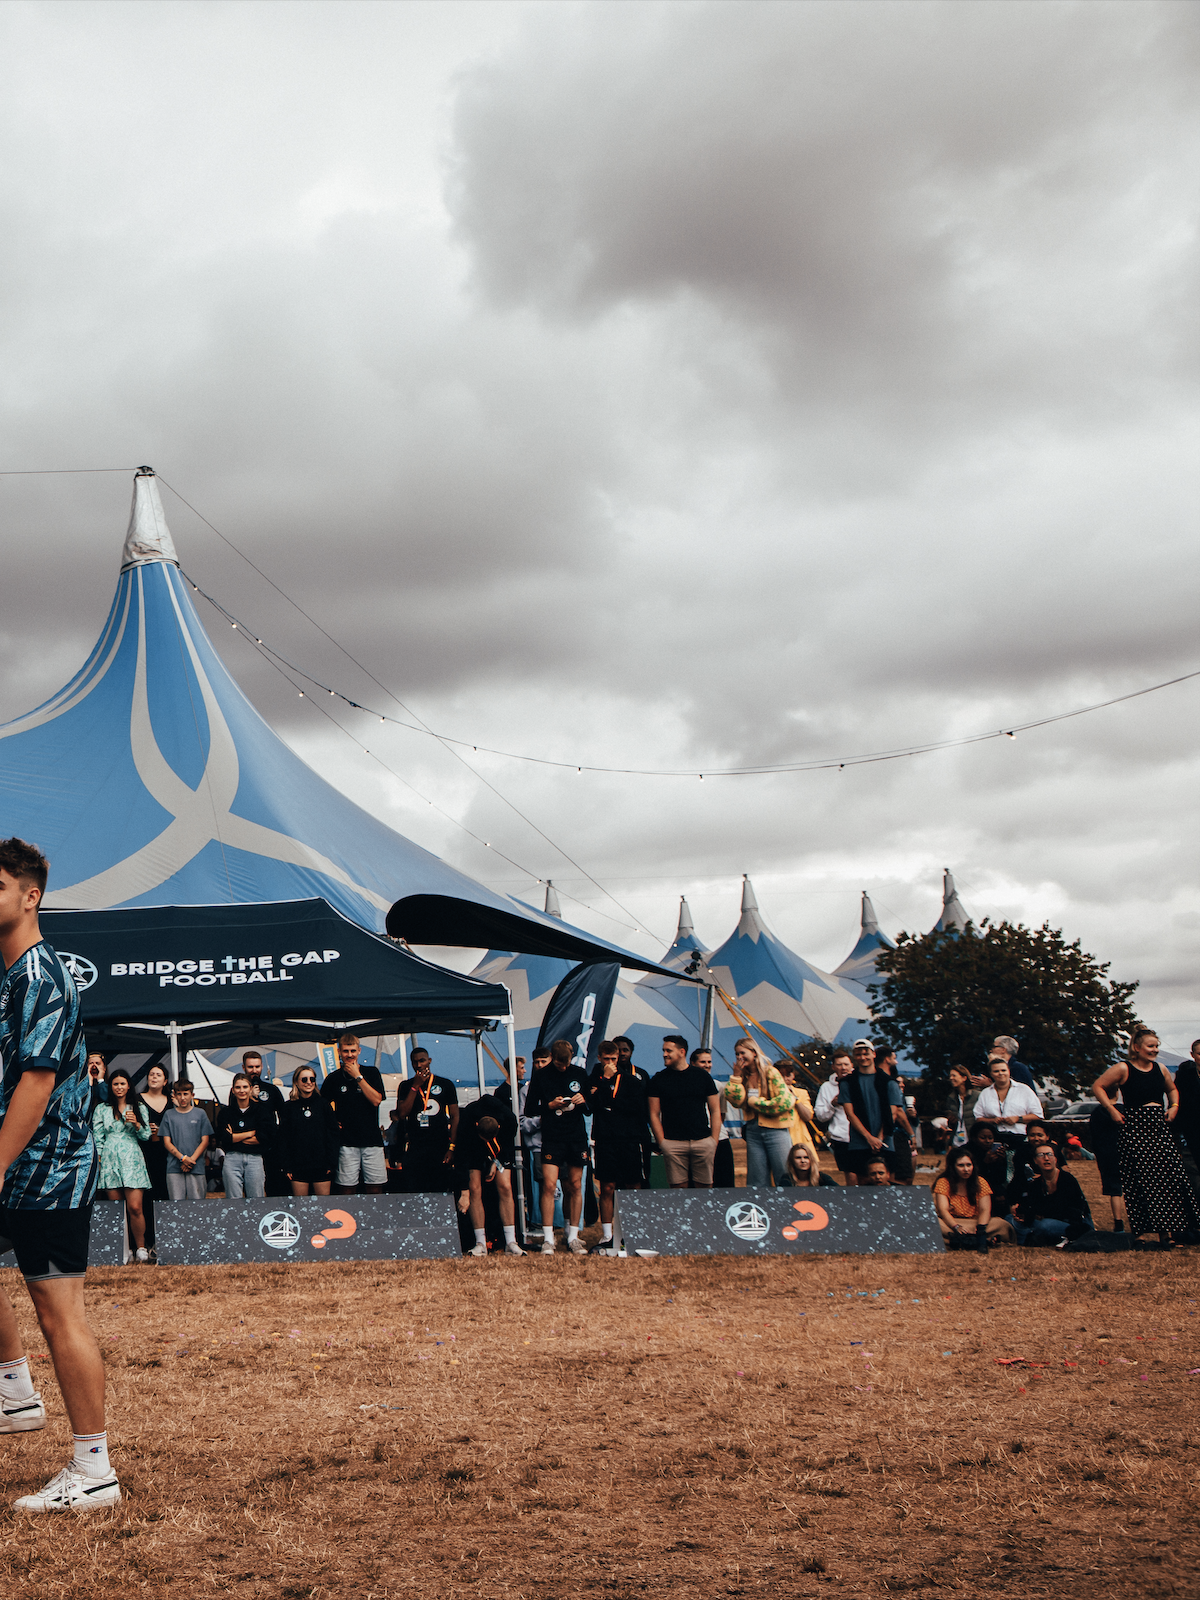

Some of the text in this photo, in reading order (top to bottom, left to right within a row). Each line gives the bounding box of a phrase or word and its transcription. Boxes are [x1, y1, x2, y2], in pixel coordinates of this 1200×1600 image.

[110, 959, 214, 976] BRIDGE
[280, 950, 341, 967] GAP
[159, 968, 294, 987] FOOTBALL
[325, 1050, 336, 1072] rfund
